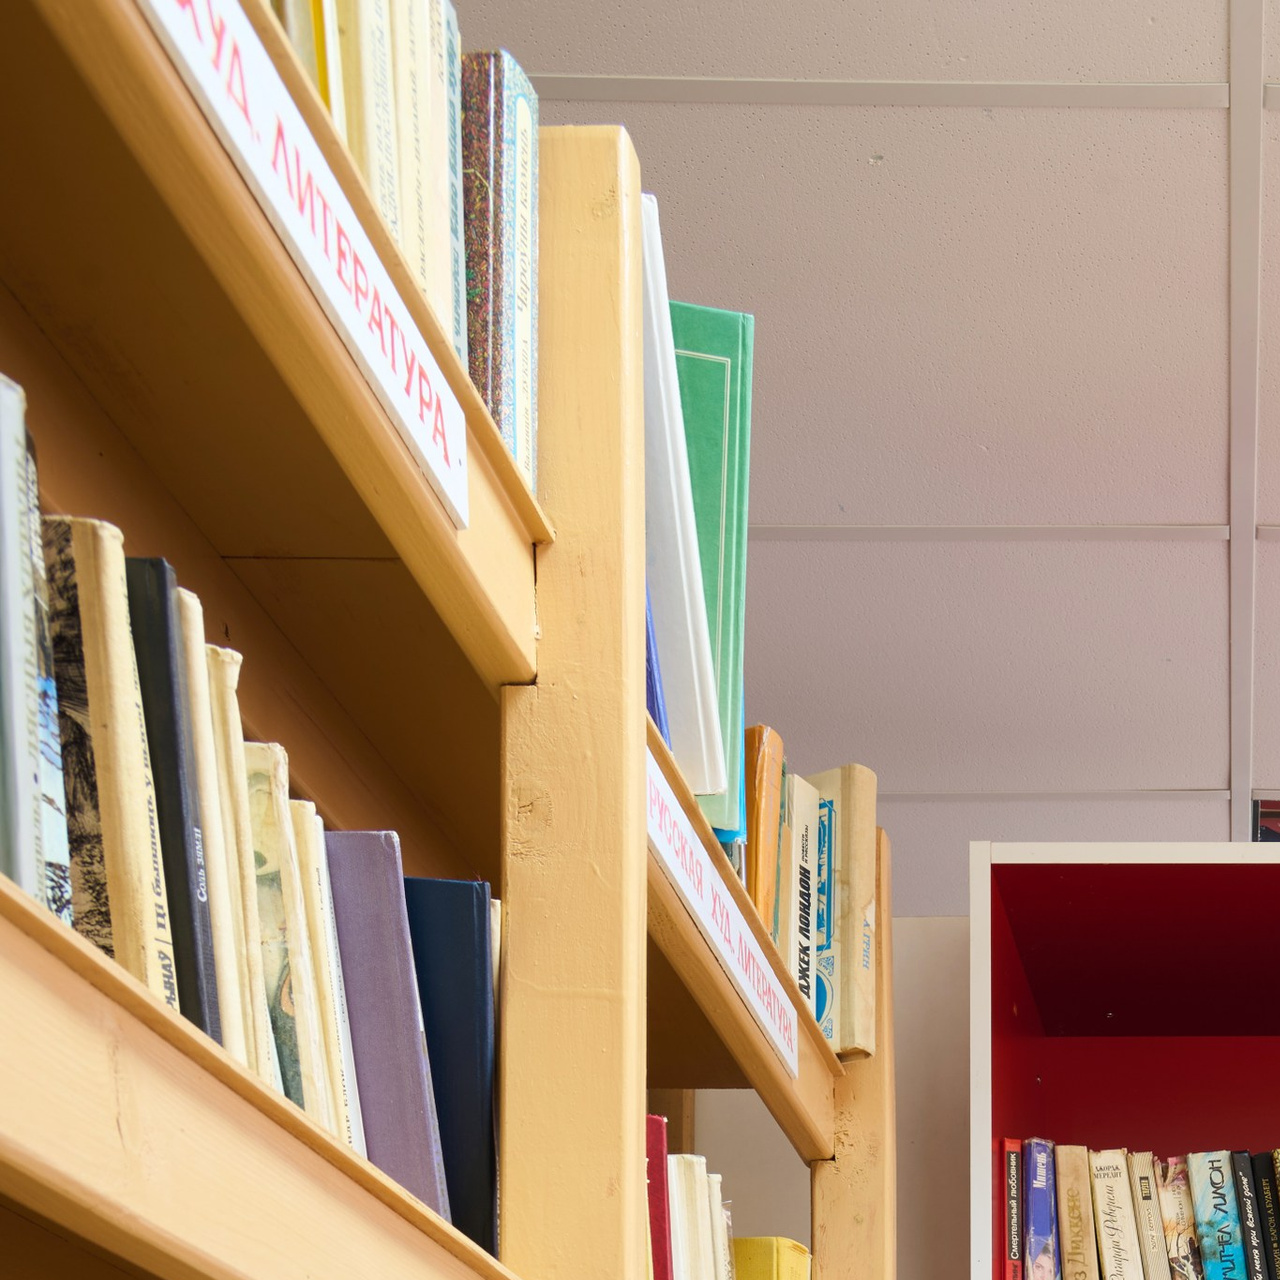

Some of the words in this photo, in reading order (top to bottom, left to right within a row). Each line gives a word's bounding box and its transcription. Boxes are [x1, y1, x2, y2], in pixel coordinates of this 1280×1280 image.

[271, 113, 452, 468] ЛИТЕРАТУРА
[799, 864, 811, 940] ЛОНДОН
[737, 930, 794, 1054] ЛИТЕРАТУРА
[799, 940, 811, 999] ДЖЕК
[1009, 1153, 1018, 1197] любовник
[1009, 1200, 1019, 1259] Смертельный
[1065, 1188, 1089, 1266] Диккенс
